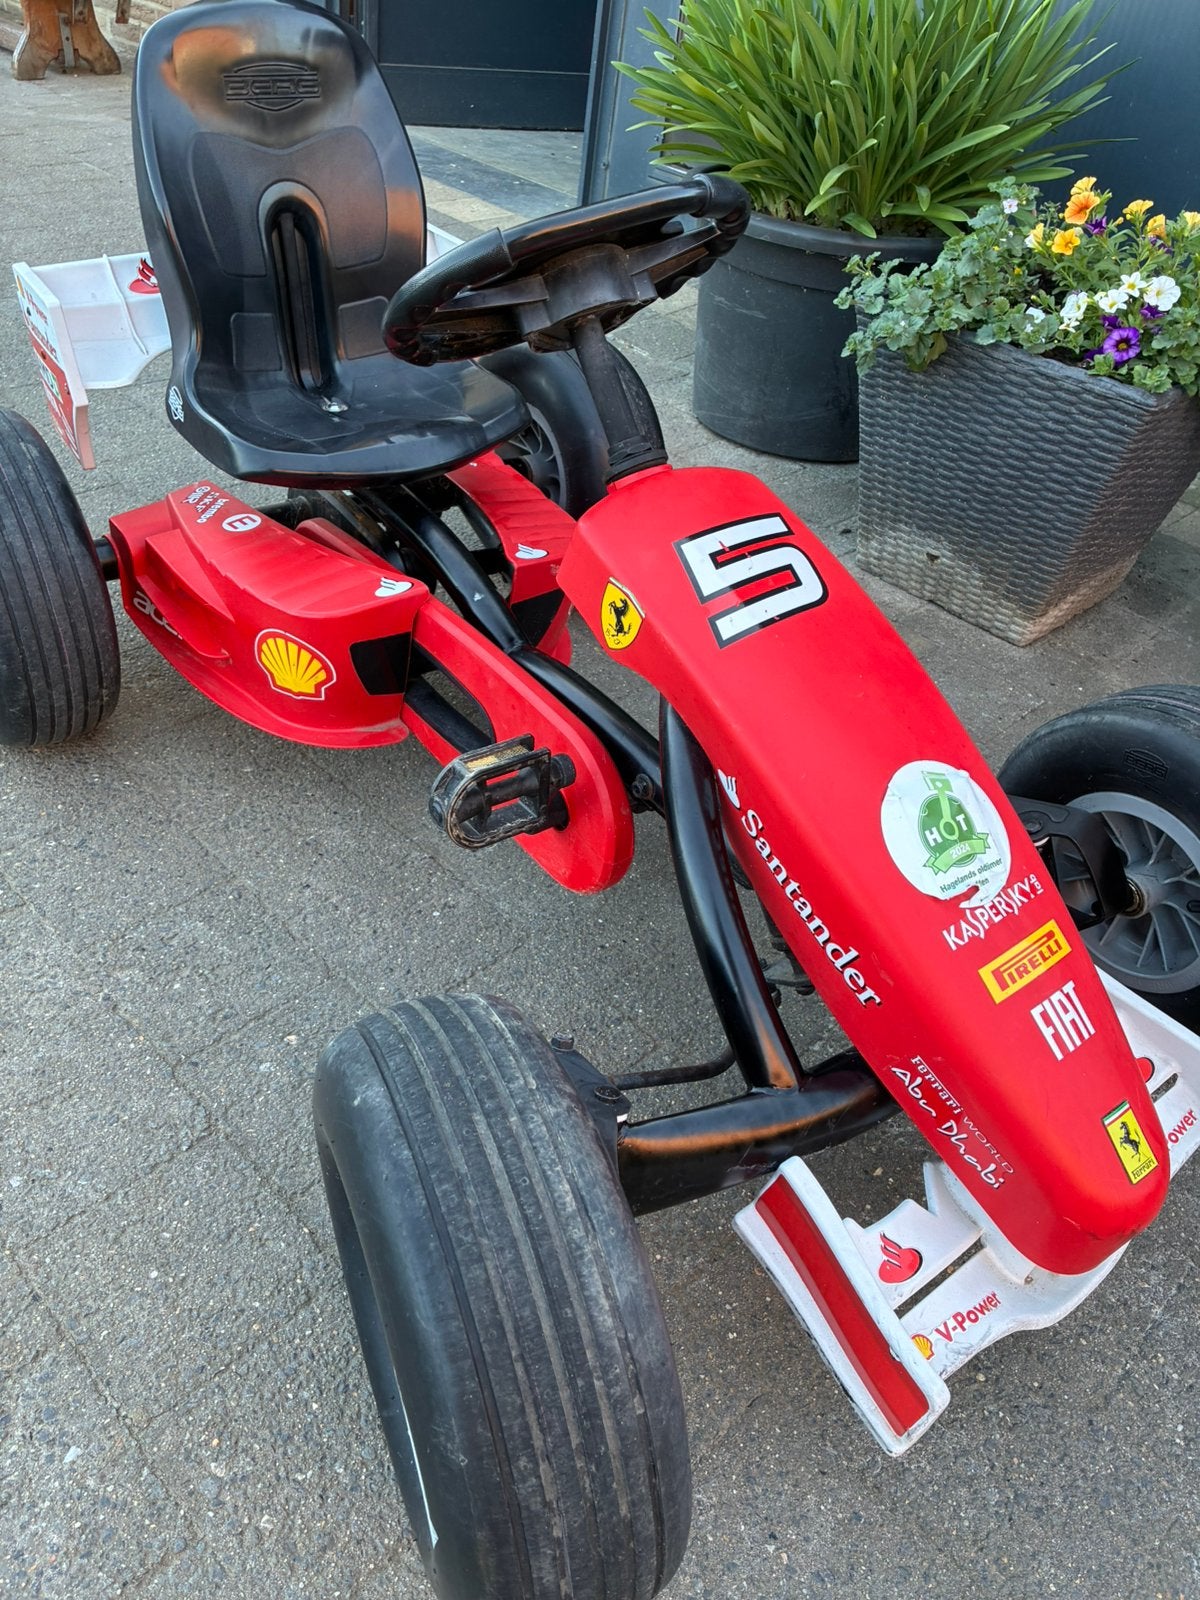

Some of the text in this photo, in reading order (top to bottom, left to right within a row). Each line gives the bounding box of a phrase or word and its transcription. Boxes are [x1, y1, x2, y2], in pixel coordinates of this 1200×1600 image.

[672, 512, 829, 649] 5
[741, 809, 882, 1007] Santander
[940, 869, 977, 893] Hagelands
[942, 877, 1034, 951] KASPERSKY
[991, 929, 1063, 992] PIRELLI
[1030, 979, 1096, 1061] FIAT
[890, 1066, 1005, 1189] Abu Dhabi
[911, 1055, 1014, 1173] Ferrari WORLD
[1167, 1108, 1198, 1144] ower
[1131, 1157, 1156, 1180] Ferrari
[934, 1291, 1001, 1343] V-Power
